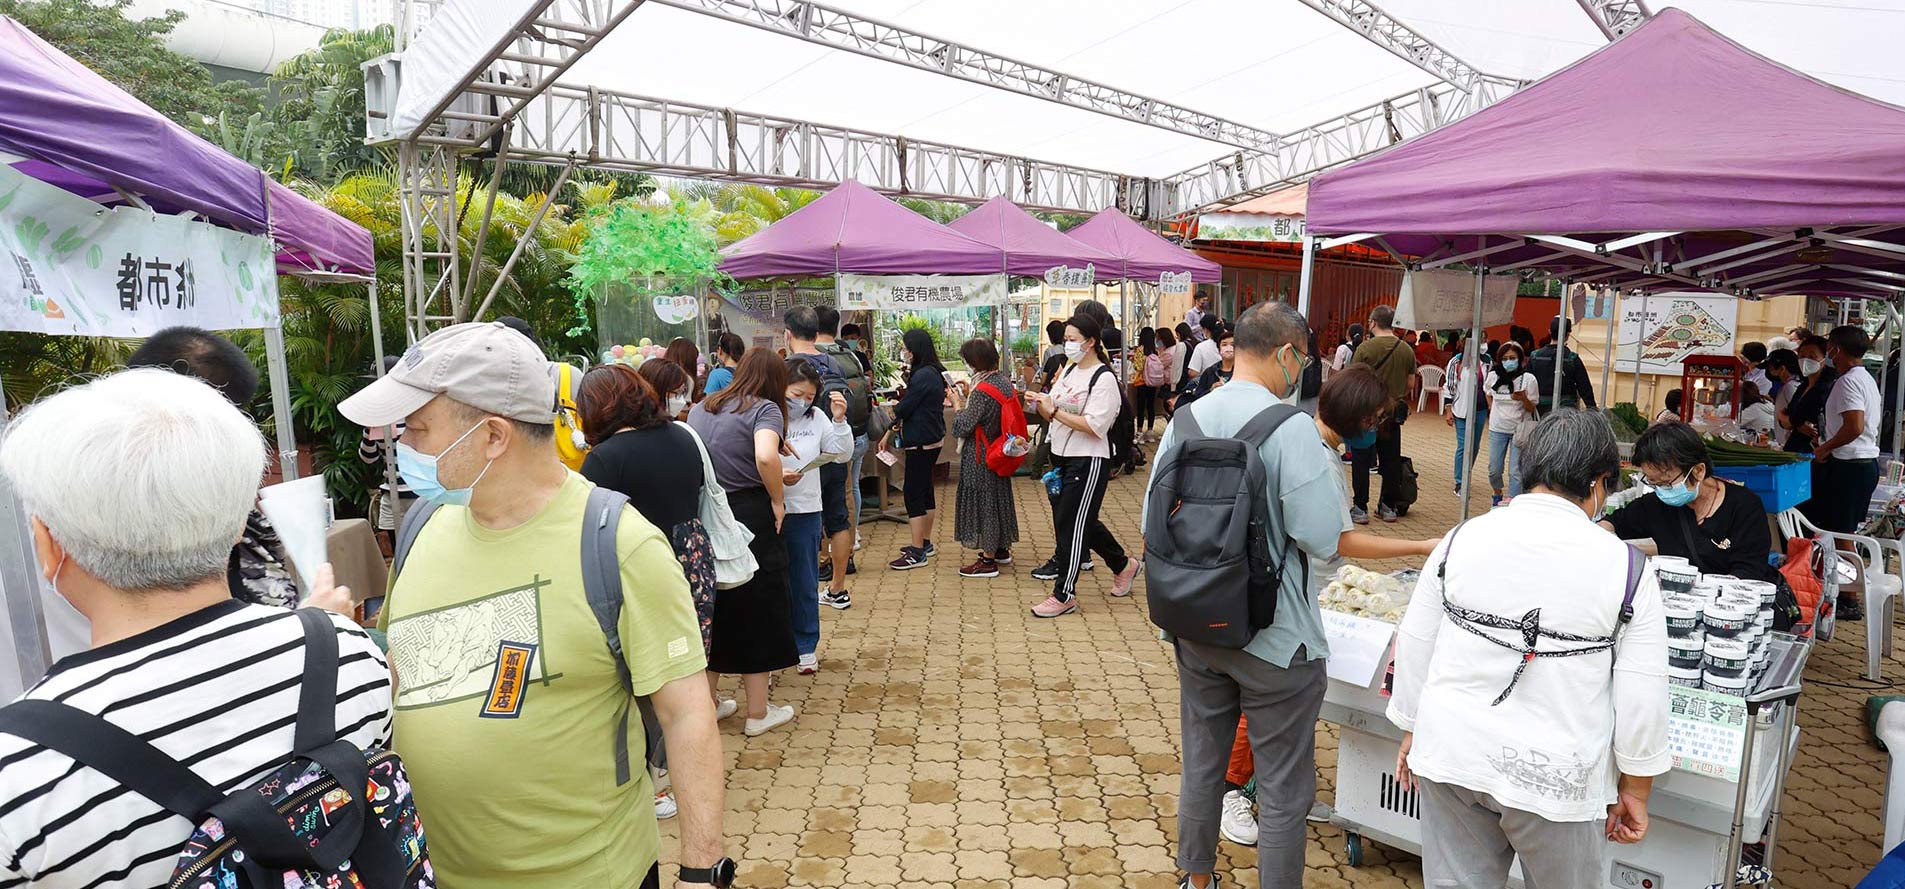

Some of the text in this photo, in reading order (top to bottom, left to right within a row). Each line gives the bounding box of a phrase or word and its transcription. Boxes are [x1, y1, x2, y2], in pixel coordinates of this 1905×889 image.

[891, 285, 964, 302] 俊君有機農場
[1668, 692, 1747, 726] 薈龜苓膏
[302, 811, 313, 832] dim
[310, 806, 320, 830] sum
